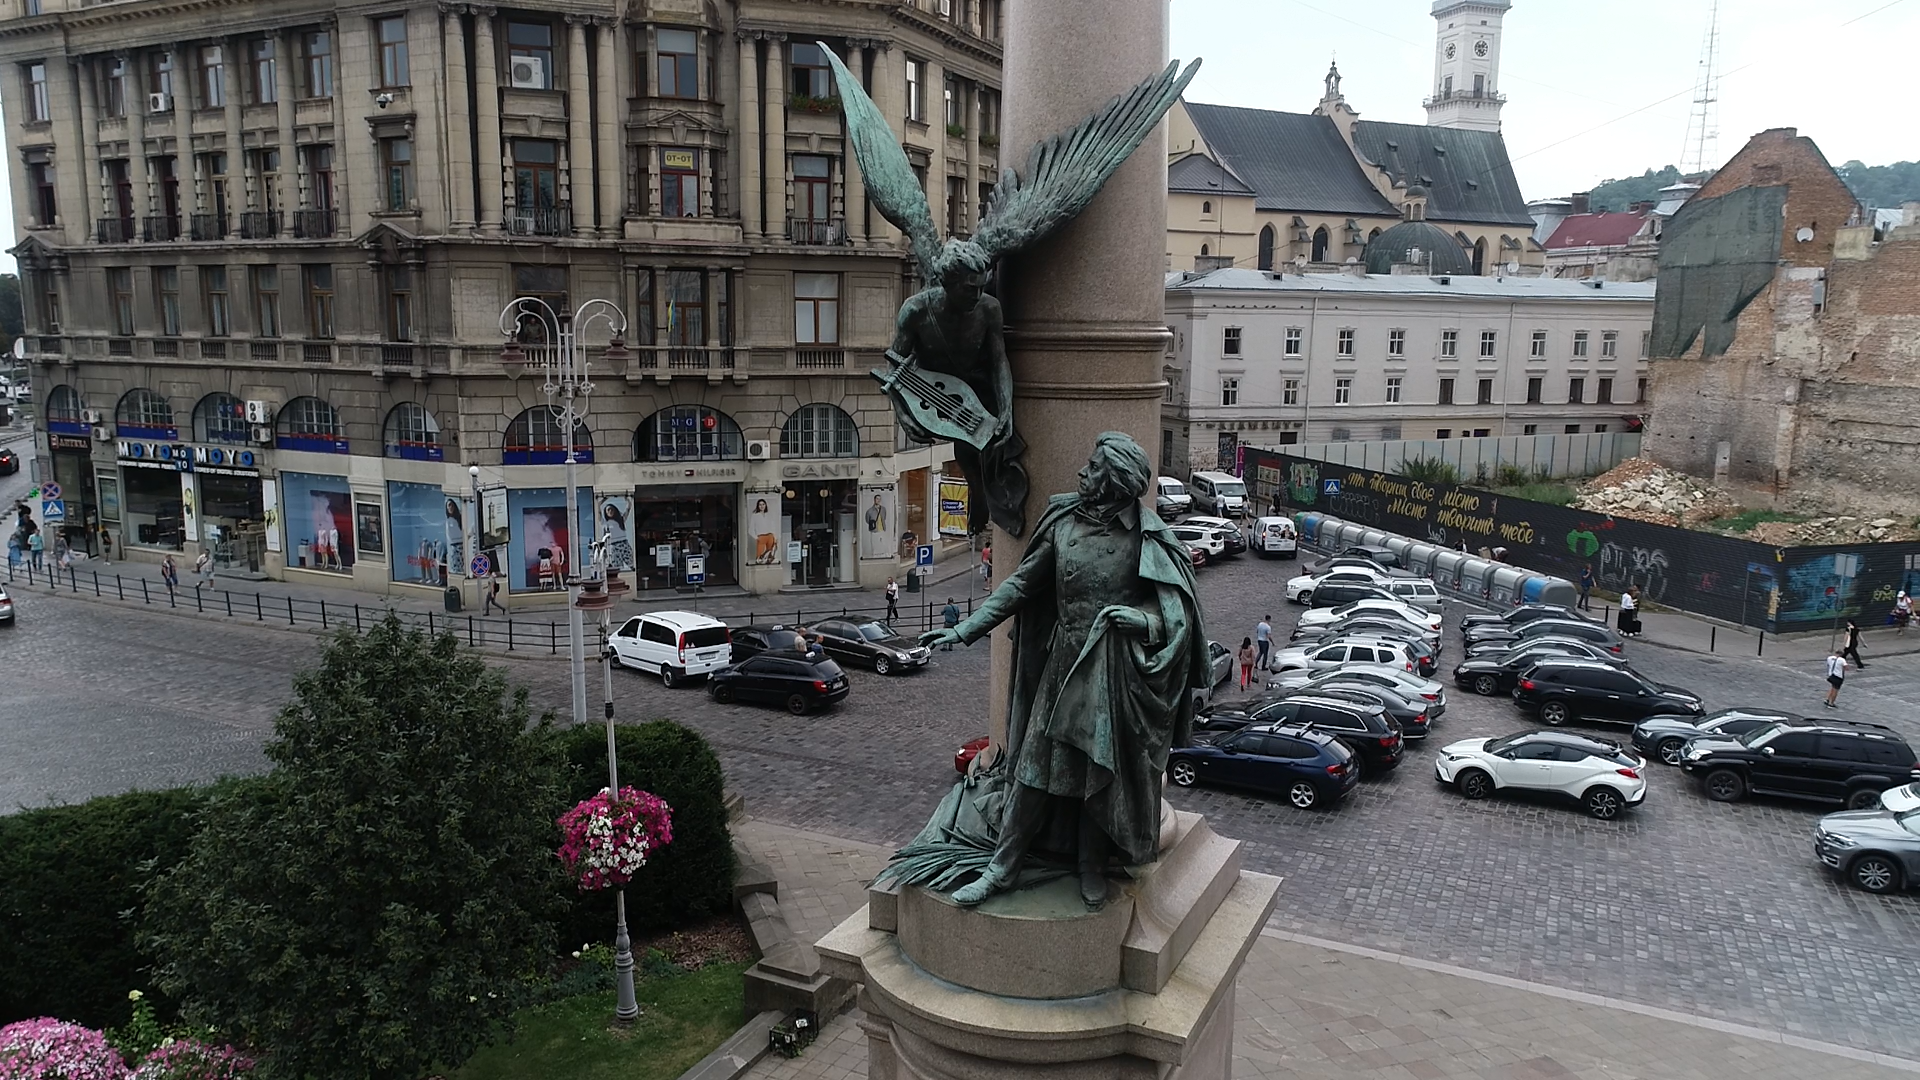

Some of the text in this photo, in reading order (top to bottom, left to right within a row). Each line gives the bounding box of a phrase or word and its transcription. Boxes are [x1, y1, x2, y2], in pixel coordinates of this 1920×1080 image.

[118, 442, 172, 460] MOYO
[195, 447, 254, 466] MOYO
[642, 468, 736, 478] TOMMY HILFIGER
[783, 463, 857, 478] GANT
[920, 547, 930, 564] P
